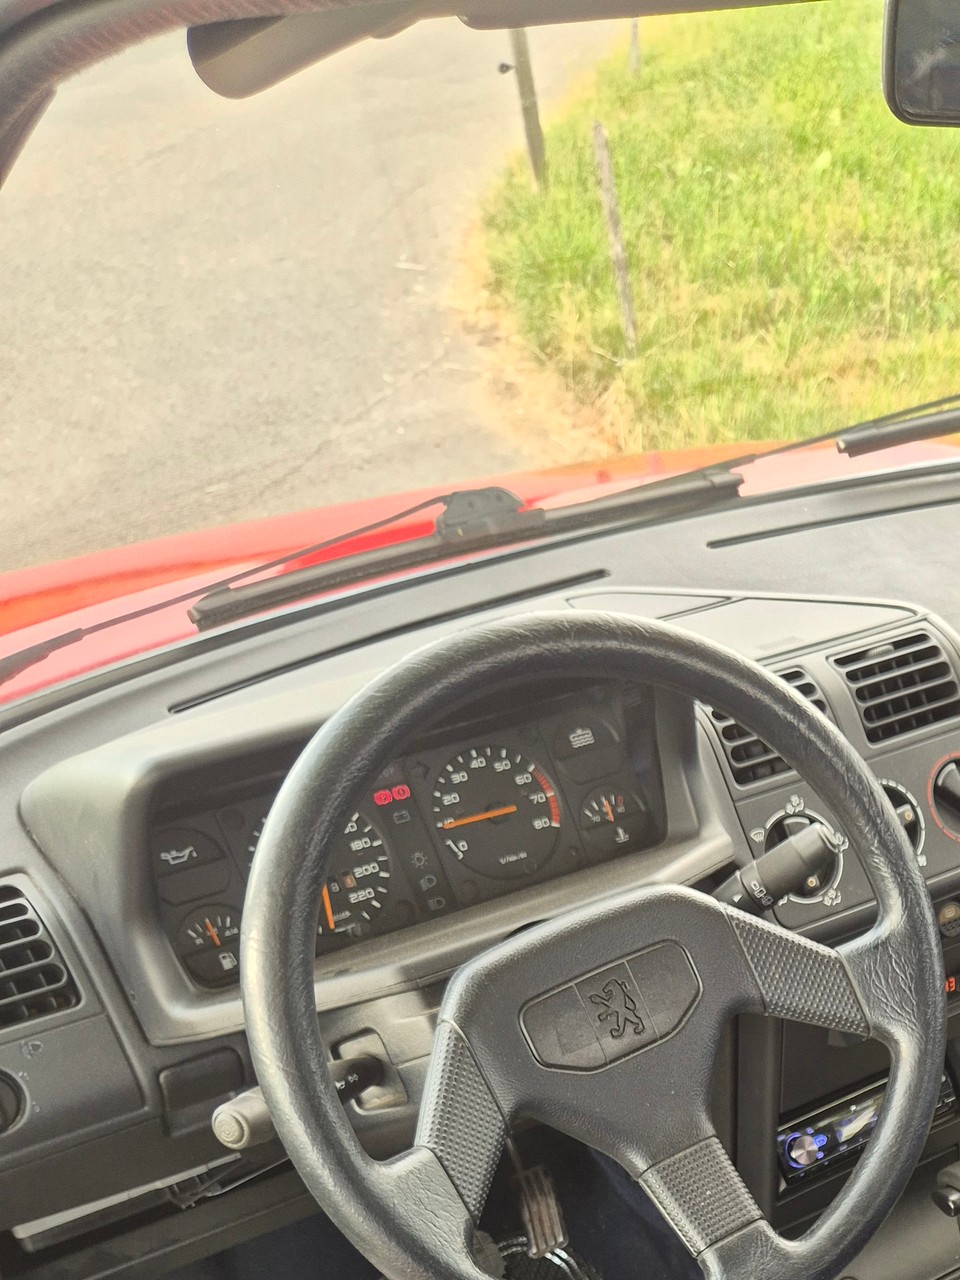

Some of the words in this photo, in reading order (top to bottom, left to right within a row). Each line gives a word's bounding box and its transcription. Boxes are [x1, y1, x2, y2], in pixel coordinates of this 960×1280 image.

[470, 757, 487, 769] 40
[493, 760, 511, 772] 50
[450, 771, 468, 784] 30
[514, 773, 533, 785] 60
[442, 792, 460, 805] 20
[529, 792, 546, 804] 70
[533, 817, 549, 829] 80
[350, 837, 371, 851] 180
[353, 862, 379, 877] 200
[349, 887, 374, 903] 220
